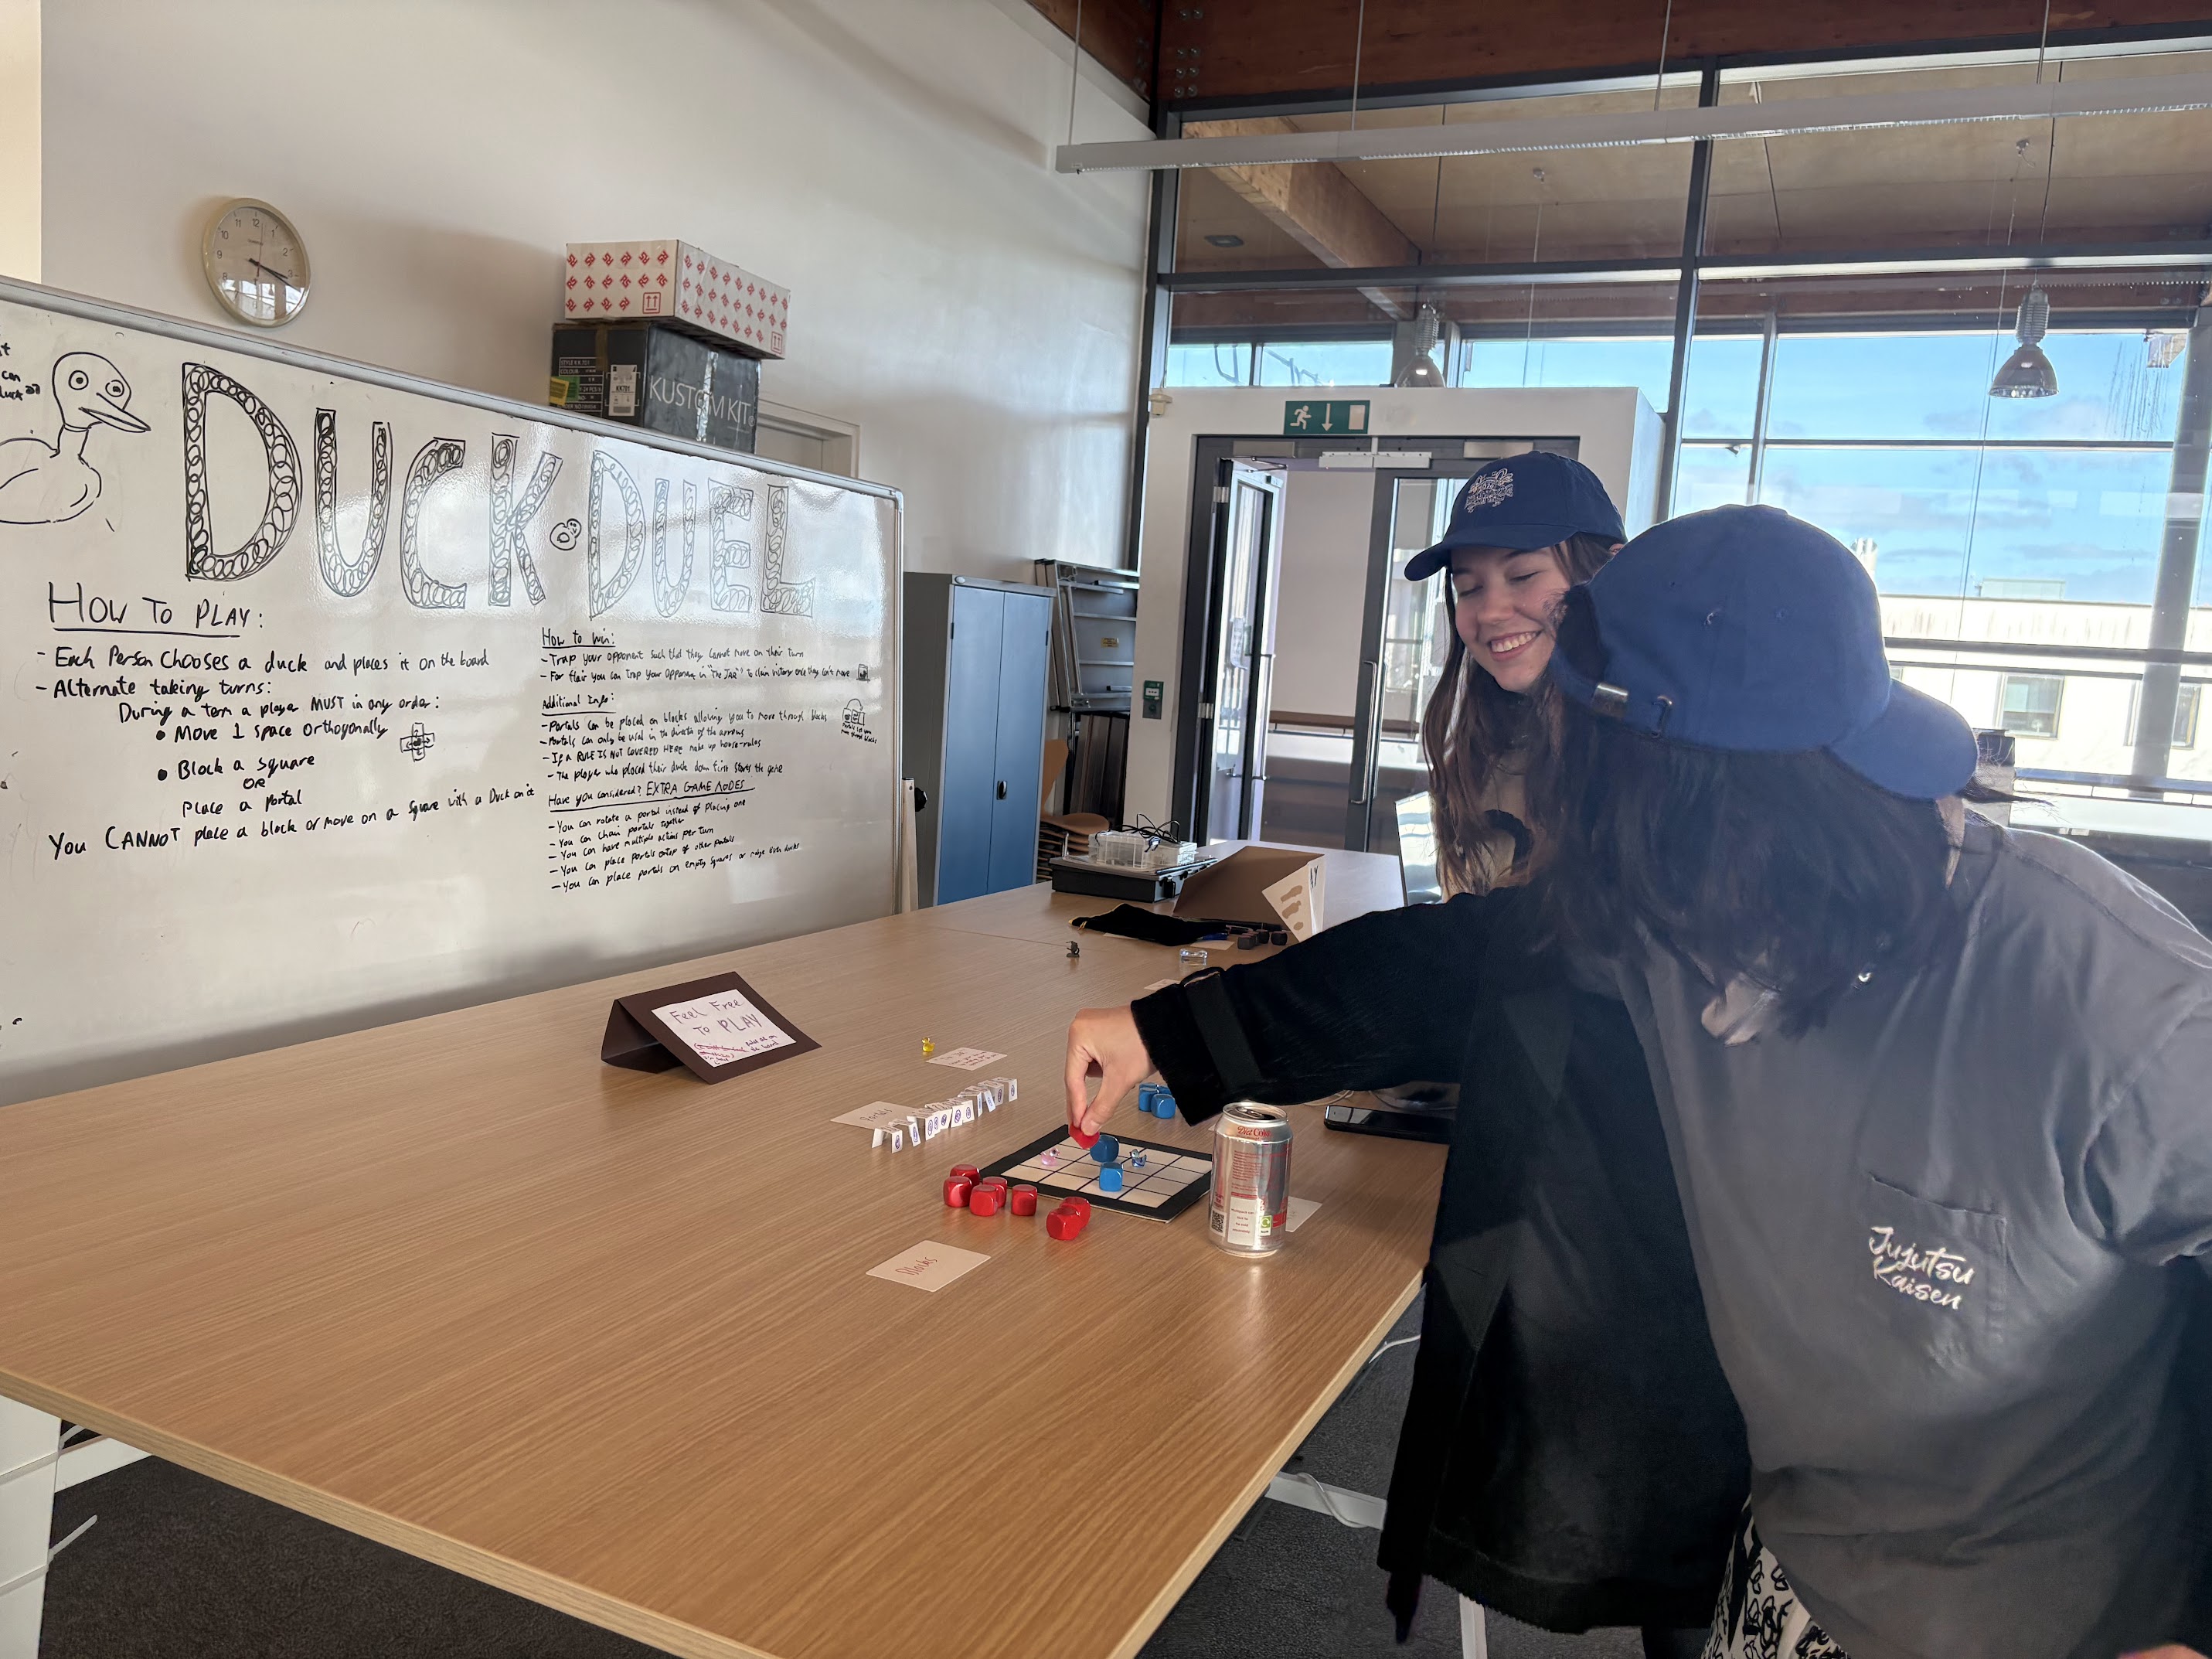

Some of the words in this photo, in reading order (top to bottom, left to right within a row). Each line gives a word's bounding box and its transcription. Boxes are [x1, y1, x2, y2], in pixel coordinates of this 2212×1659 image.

[182, 362, 563, 609] DUCK
[589, 450, 816, 621] DUEL
[48, 581, 127, 625] HOW
[141, 597, 172, 625] TO
[196, 599, 264, 629] PLAY:
[311, 696, 344, 712] MUST
[105, 826, 181, 850] CANNOT
[1873, 1255, 1963, 1310] Kaisen
